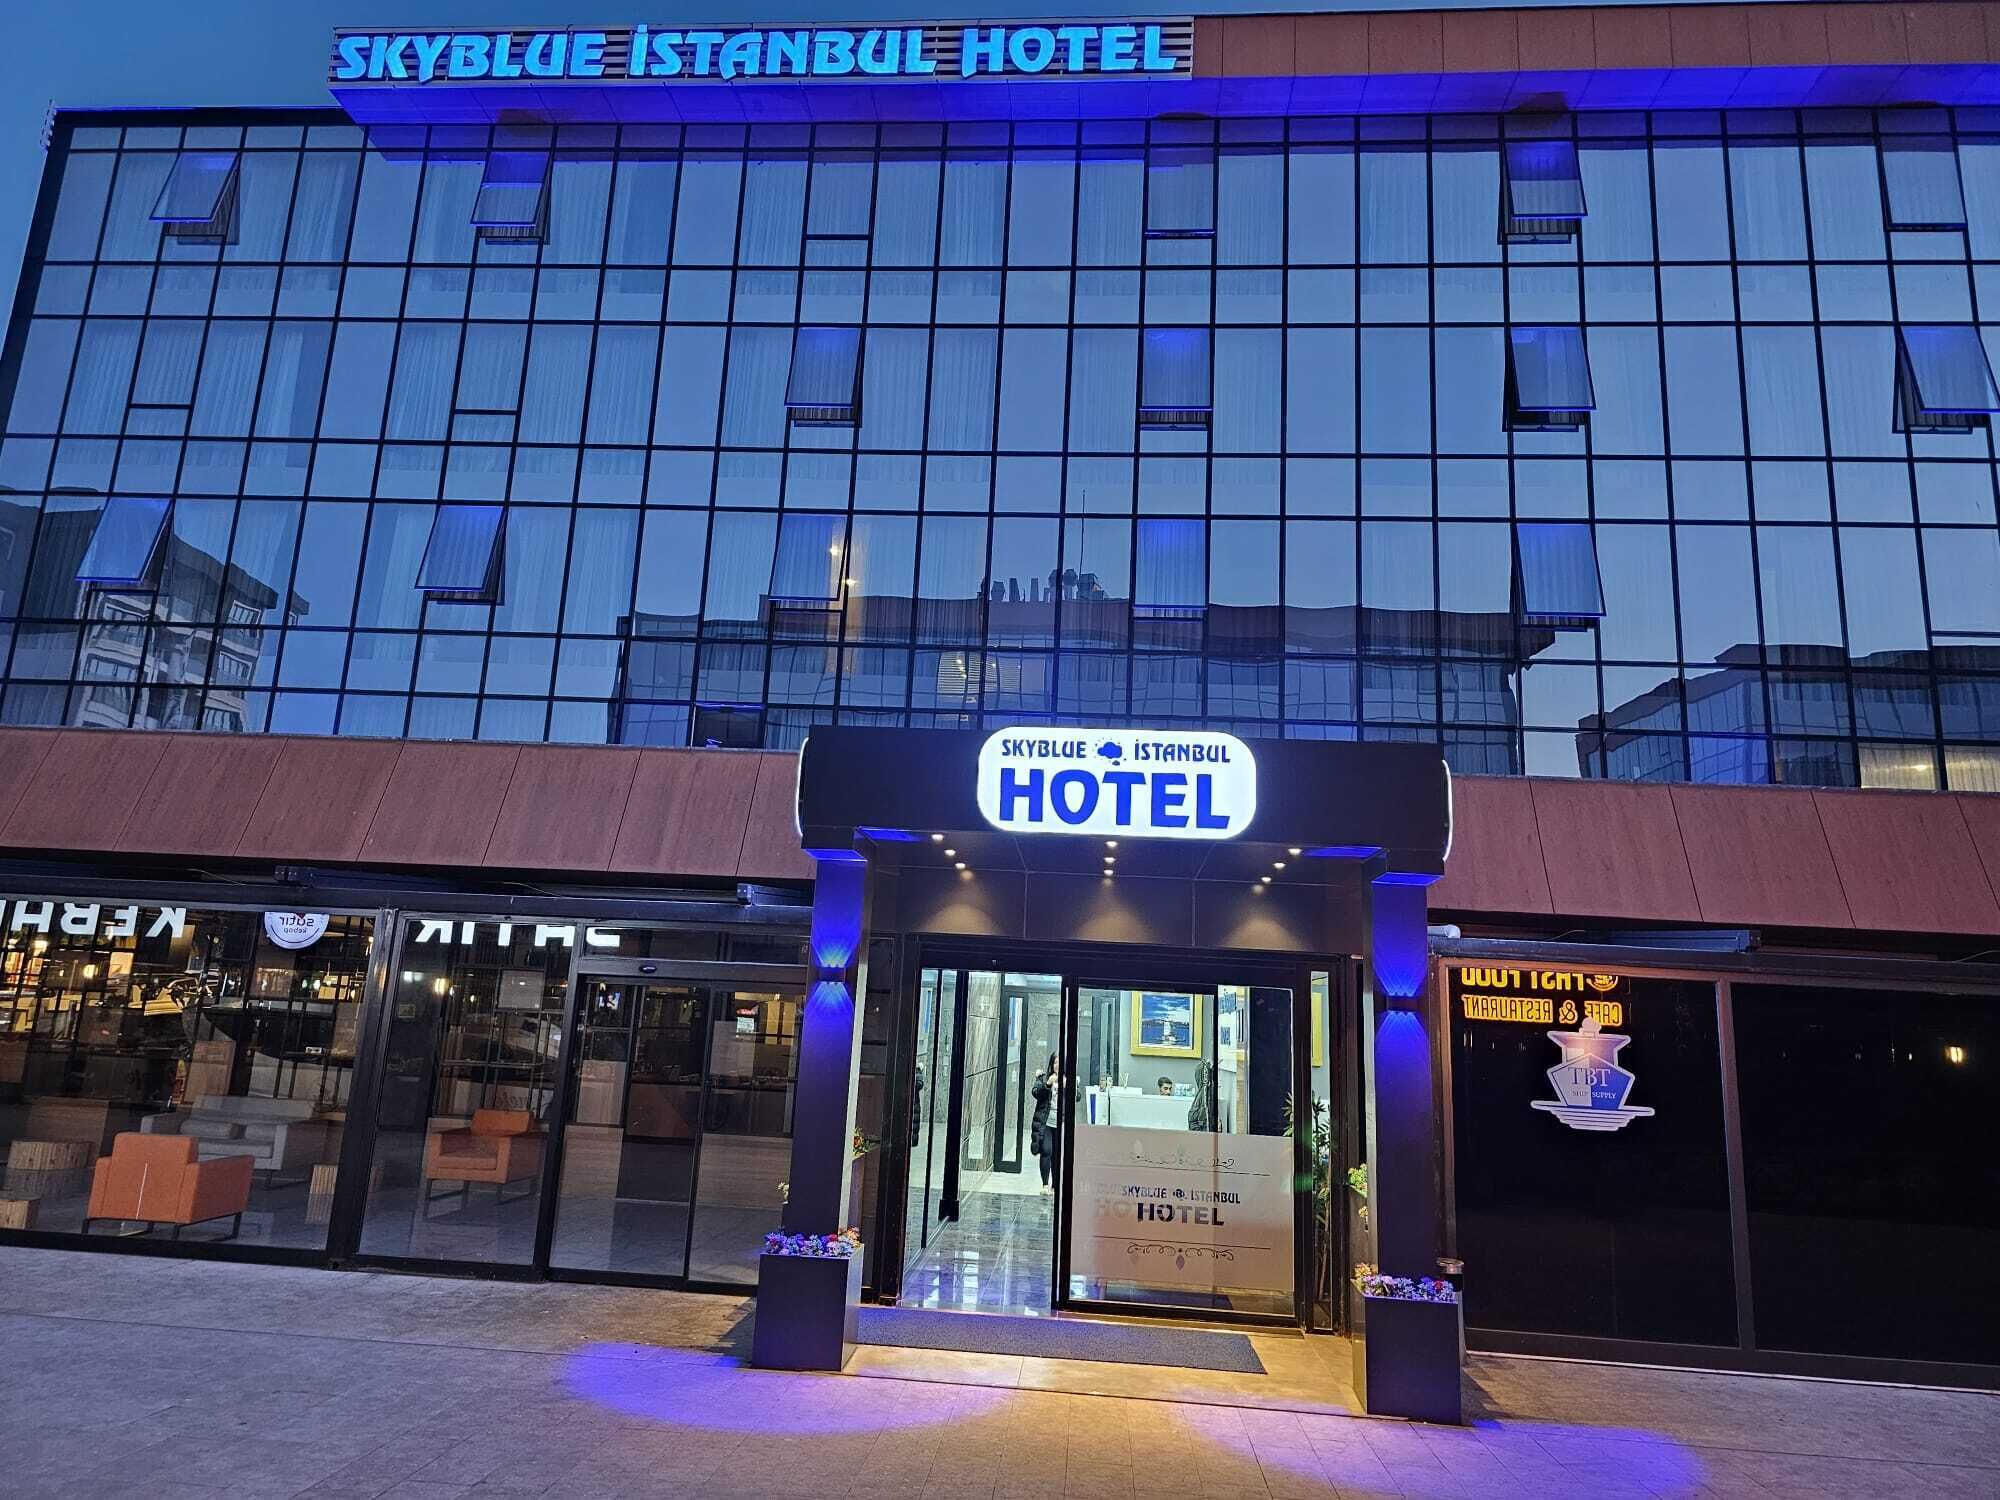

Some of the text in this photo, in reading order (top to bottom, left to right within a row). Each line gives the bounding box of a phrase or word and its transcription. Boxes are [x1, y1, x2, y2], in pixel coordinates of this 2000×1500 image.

[337, 24, 1177, 83] SKYBLUE İSTANBUL HOTEL
[1002, 739, 1231, 763] SKYBLUE İSTANBUL
[999, 768, 1231, 829] HOTEL
[1568, 1066, 1611, 1087] TBT
[1122, 1185, 1167, 1199] SKYBLUE
[1137, 1202, 1225, 1226] HOTEL
